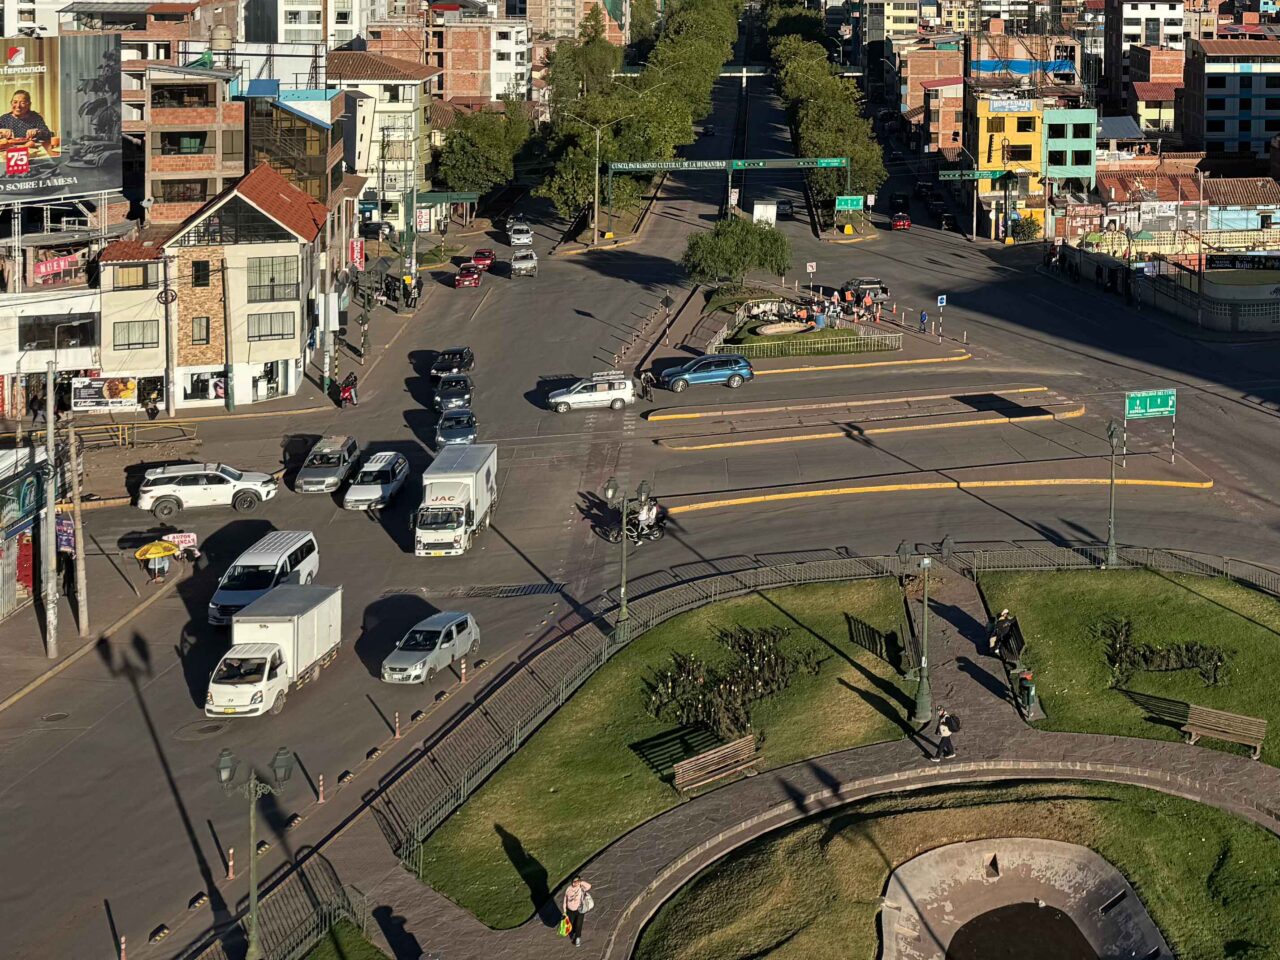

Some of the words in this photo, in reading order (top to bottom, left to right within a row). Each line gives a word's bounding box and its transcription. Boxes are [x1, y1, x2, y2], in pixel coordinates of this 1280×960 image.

[8, 151, 28, 165] 75
[6, 181, 38, 191] SOBRE
[39, 179, 51, 188] LA
[51, 176, 78, 186] MESA
